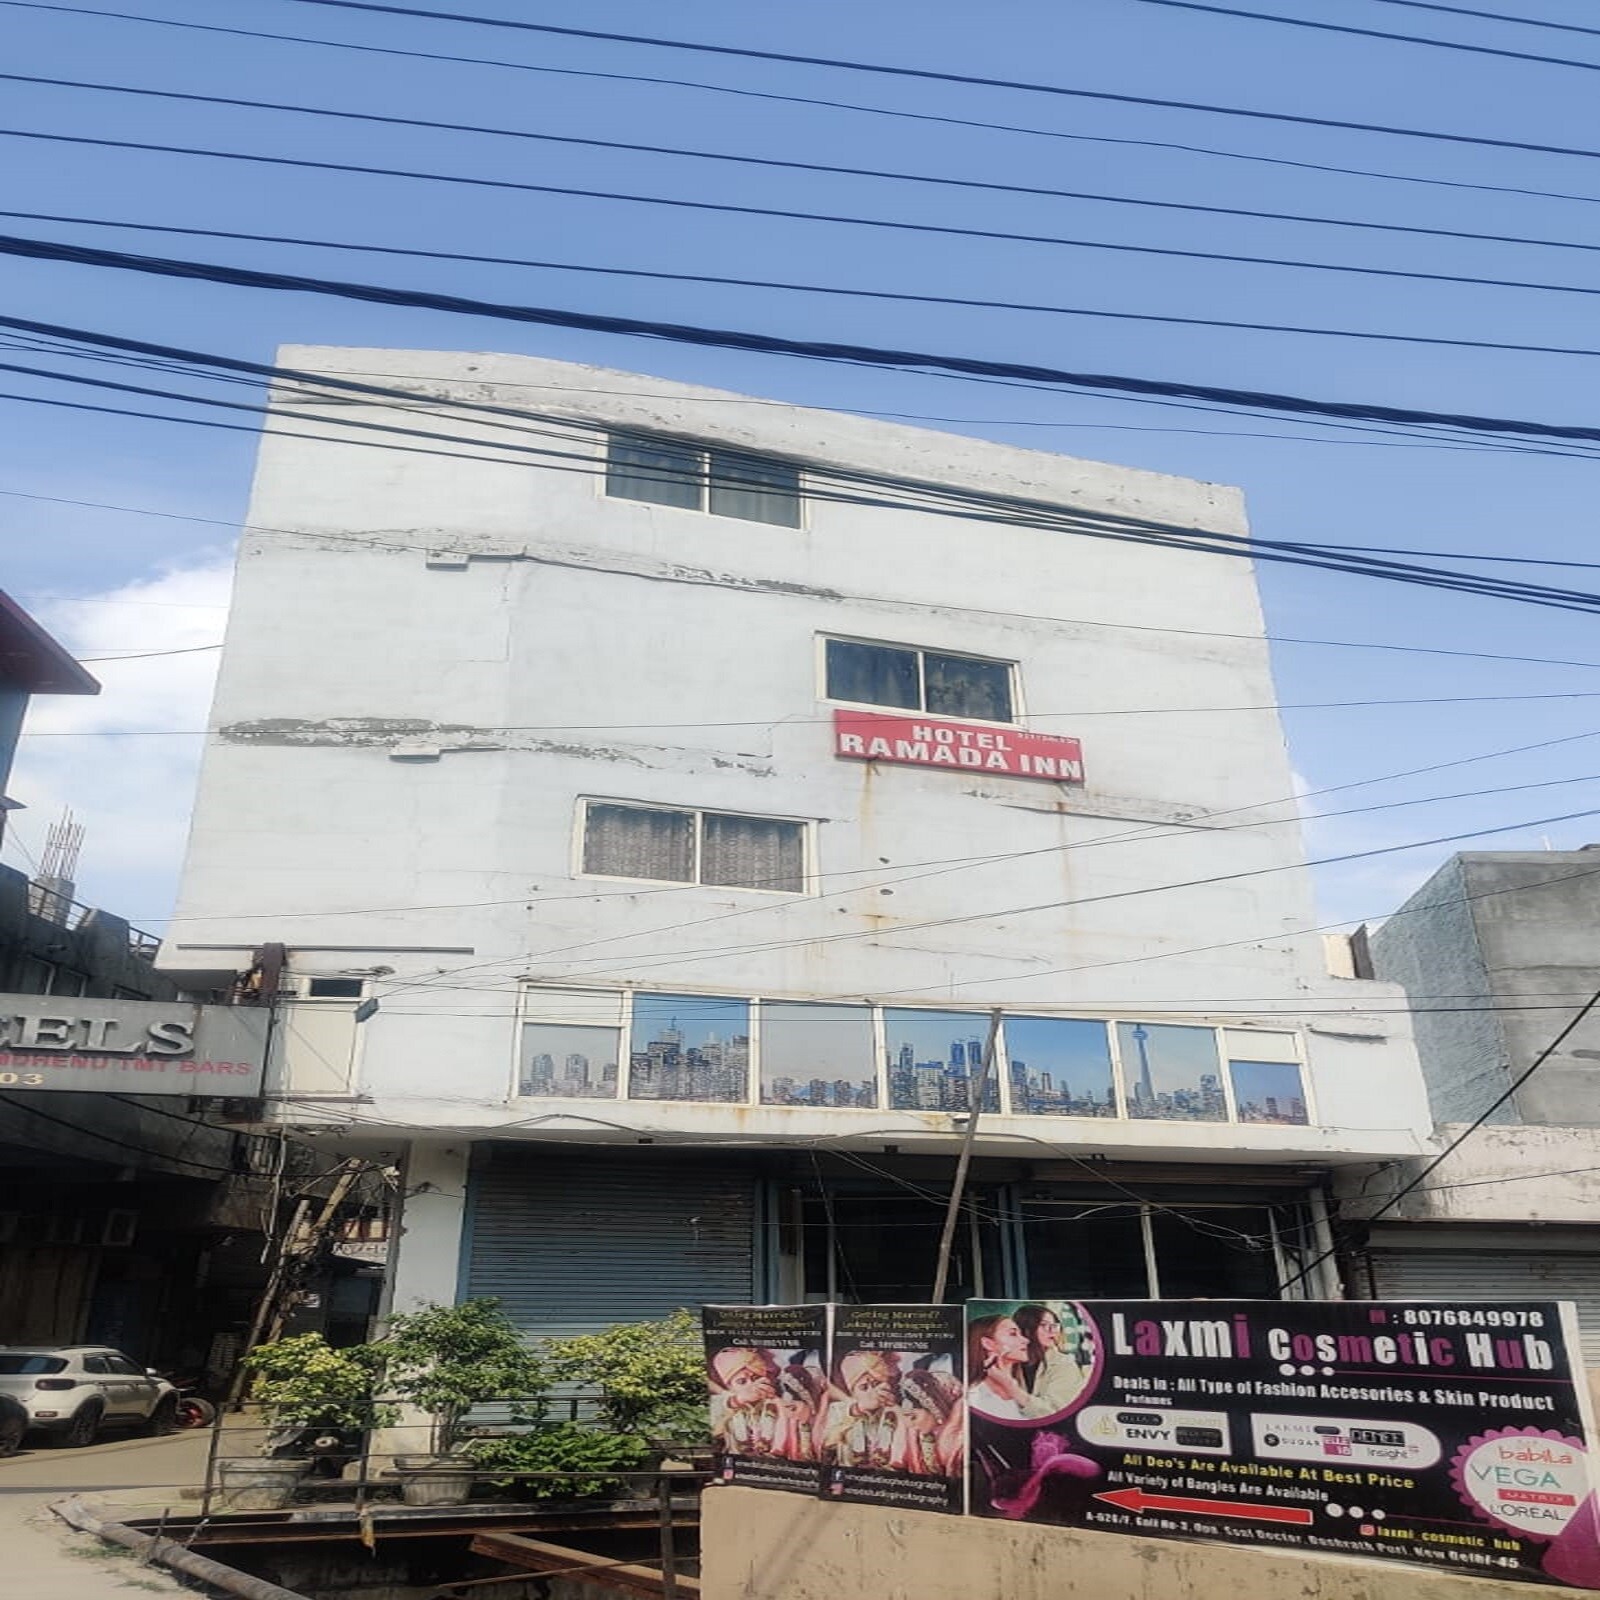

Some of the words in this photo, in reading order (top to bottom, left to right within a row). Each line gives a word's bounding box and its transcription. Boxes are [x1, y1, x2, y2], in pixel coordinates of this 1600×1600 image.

[913, 725, 1012, 750] HOTEL
[840, 733, 1009, 770] RAMADA
[1020, 754, 1081, 778] INN
[176, 1059, 250, 1076] BARS
[1404, 1310, 1544, 1328] 8076849978
[1112, 1313, 1250, 1358] Laxmi
[1268, 1328, 1454, 1366] Cosmetic
[1465, 1332, 1553, 1371] Hub
[1113, 1375, 1150, 1390] Deals
[1178, 1377, 1196, 1392] All
[1199, 1379, 1233, 1395] Type
[1237, 1381, 1252, 1395] of
[1255, 1381, 1316, 1398] Fashion
[1321, 1384, 1413, 1403] Accesories
[1419, 1390, 1428, 1403] &
[1434, 1389, 1474, 1406] Skin
[1479, 1391, 1555, 1411] Product
[1126, 1428, 1170, 1441] ENVY
[1123, 1453, 1142, 1466] All
[1146, 1456, 1186, 1470] Deo's
[1191, 1460, 1215, 1471] Are
[1220, 1461, 1294, 1479] Available
[1300, 1467, 1317, 1481] At
[1323, 1469, 1361, 1485] Best
[1367, 1472, 1415, 1489] Price
[1470, 1463, 1561, 1488] VEGA
[1108, 1470, 1123, 1482] All
[1126, 1473, 1168, 1489] Variety
[1171, 1477, 1183, 1488] of
[1186, 1478, 1236, 1494] Bangles
[1239, 1482, 1262, 1496] Are
[1266, 1485, 1329, 1502] Available
